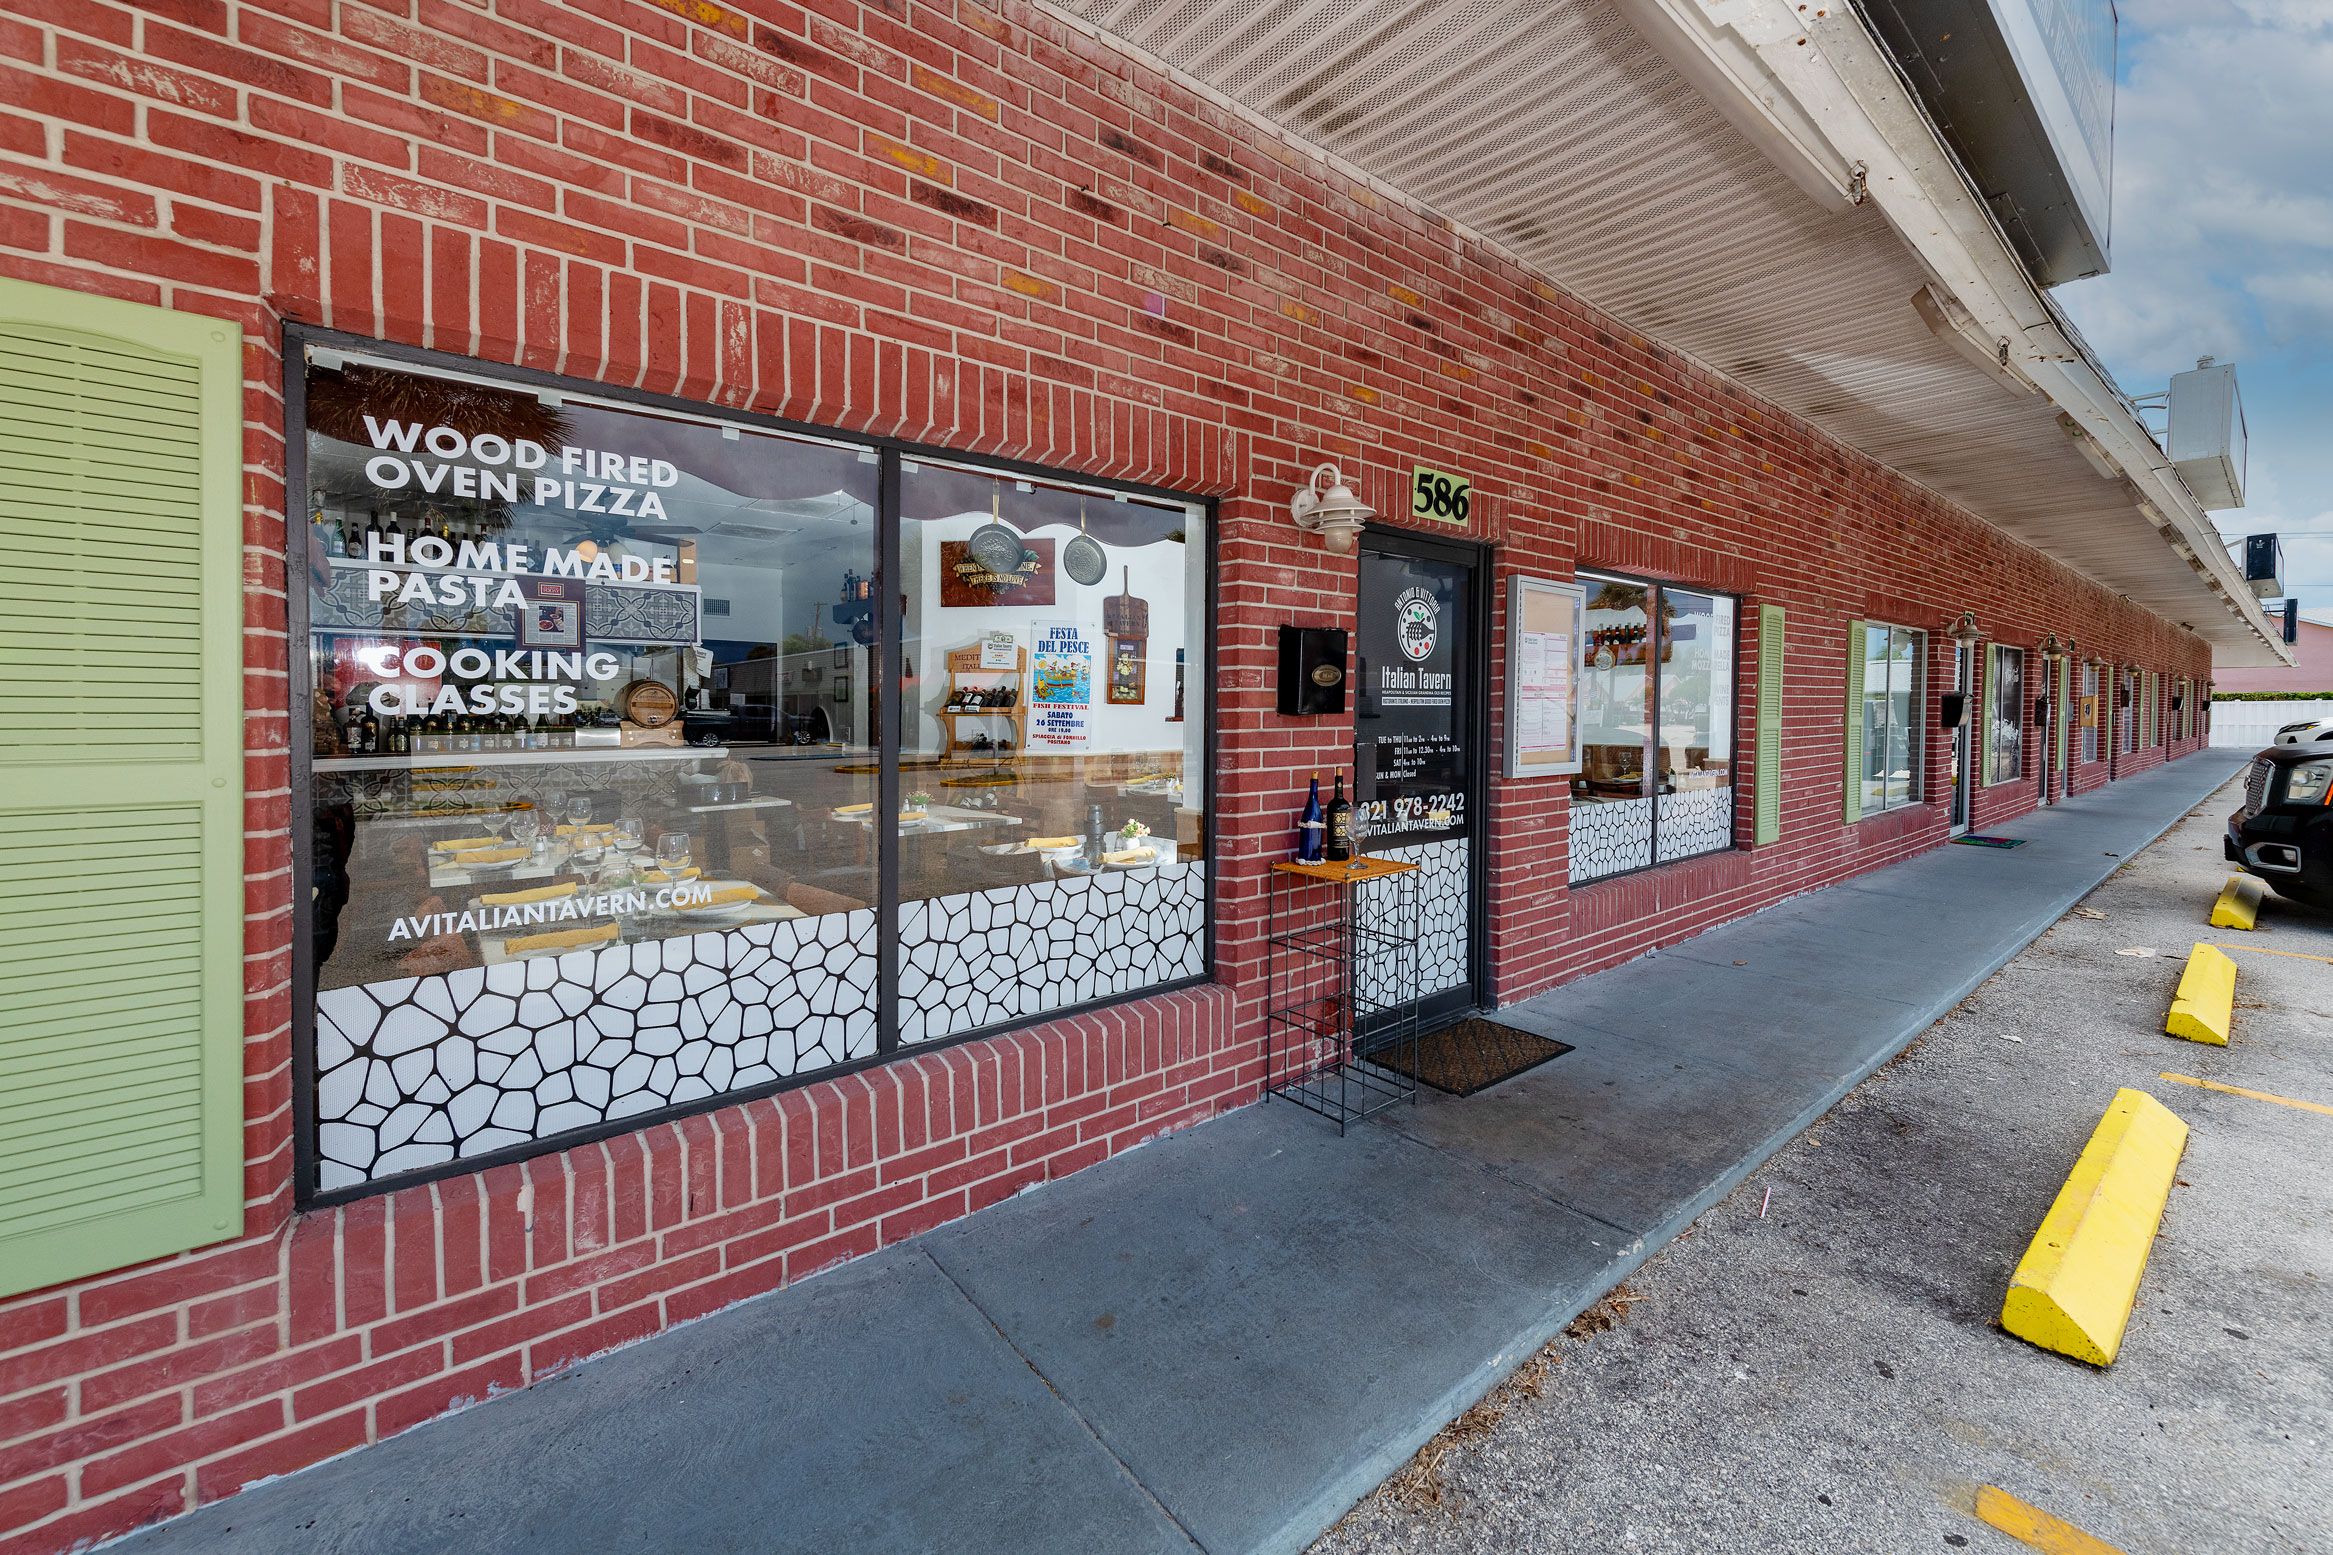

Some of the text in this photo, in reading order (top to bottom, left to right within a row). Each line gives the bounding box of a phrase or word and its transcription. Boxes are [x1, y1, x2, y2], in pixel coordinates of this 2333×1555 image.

[363, 415, 679, 488] WOOD FIRED
[365, 456, 668, 520] OVEN PIZZA
[1414, 473, 1470, 521] 586
[368, 531, 671, 585] HOME MADE
[368, 570, 529, 609] PASTA
[1038, 640, 1089, 653] DEL PESCE
[1050, 627, 1078, 640] FESTA
[367, 646, 620, 681] COOKING
[1382, 666, 1452, 690] Italian Tavern
[368, 684, 578, 715] CLASSES
[1047, 711, 1073, 719] SABATO
[1047, 719, 1084, 727] SETTEMBRE
[1378, 736, 1387, 744] TUE
[1393, 735, 1402, 744] THU
[1384, 771, 1389, 779] &
[1389, 771, 1401, 779] MON
[1402, 769, 1416, 778] Closed
[1393, 758, 1401, 767] SAT
[1359, 792, 1465, 821] 321 978-2242
[1366, 813, 1464, 837] VITALIANTAVERN.COM
[387, 884, 713, 941] AVITALIANTAVERN.COM
